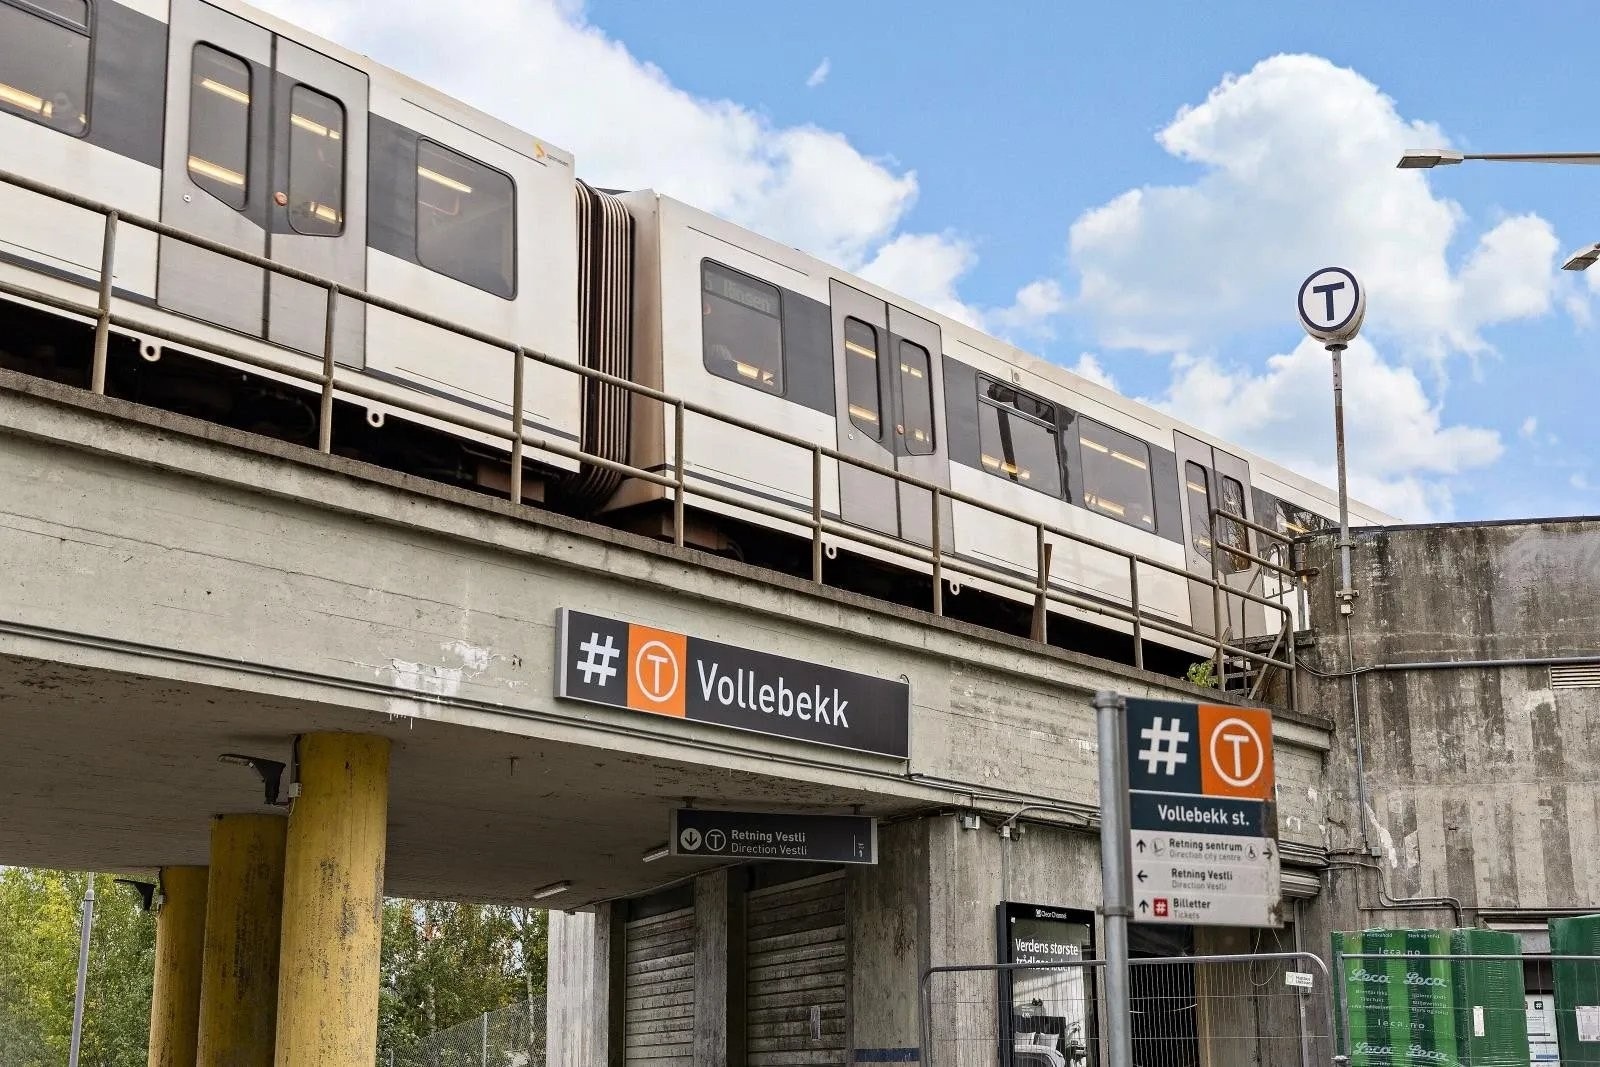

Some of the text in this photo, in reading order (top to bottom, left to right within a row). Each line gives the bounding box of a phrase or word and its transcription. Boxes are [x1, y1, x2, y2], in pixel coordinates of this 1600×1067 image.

[697, 659, 849, 728] Vollebekk
[1158, 804, 1250, 826] Vollebekk st.
[731, 829, 773, 843] Retning
[775, 831, 806, 844] Vestli
[731, 842, 807, 856] Direction Vestli
[1169, 838, 1243, 852] Retning sentrum
[1169, 849, 1241, 861] Direction city centre
[1171, 868, 1233, 881] Retning Vestli
[1172, 880, 1227, 890] Direction Vestli
[1173, 898, 1211, 909] Billetter
[1173, 910, 1201, 919] Tickets
[1015, 938, 1079, 956] Verdens største
[1349, 968, 1391, 983] Leca
[1403, 971, 1448, 988] Leca
[1378, 1019, 1425, 1029] leca.no
[1353, 1041, 1394, 1055] Leca
